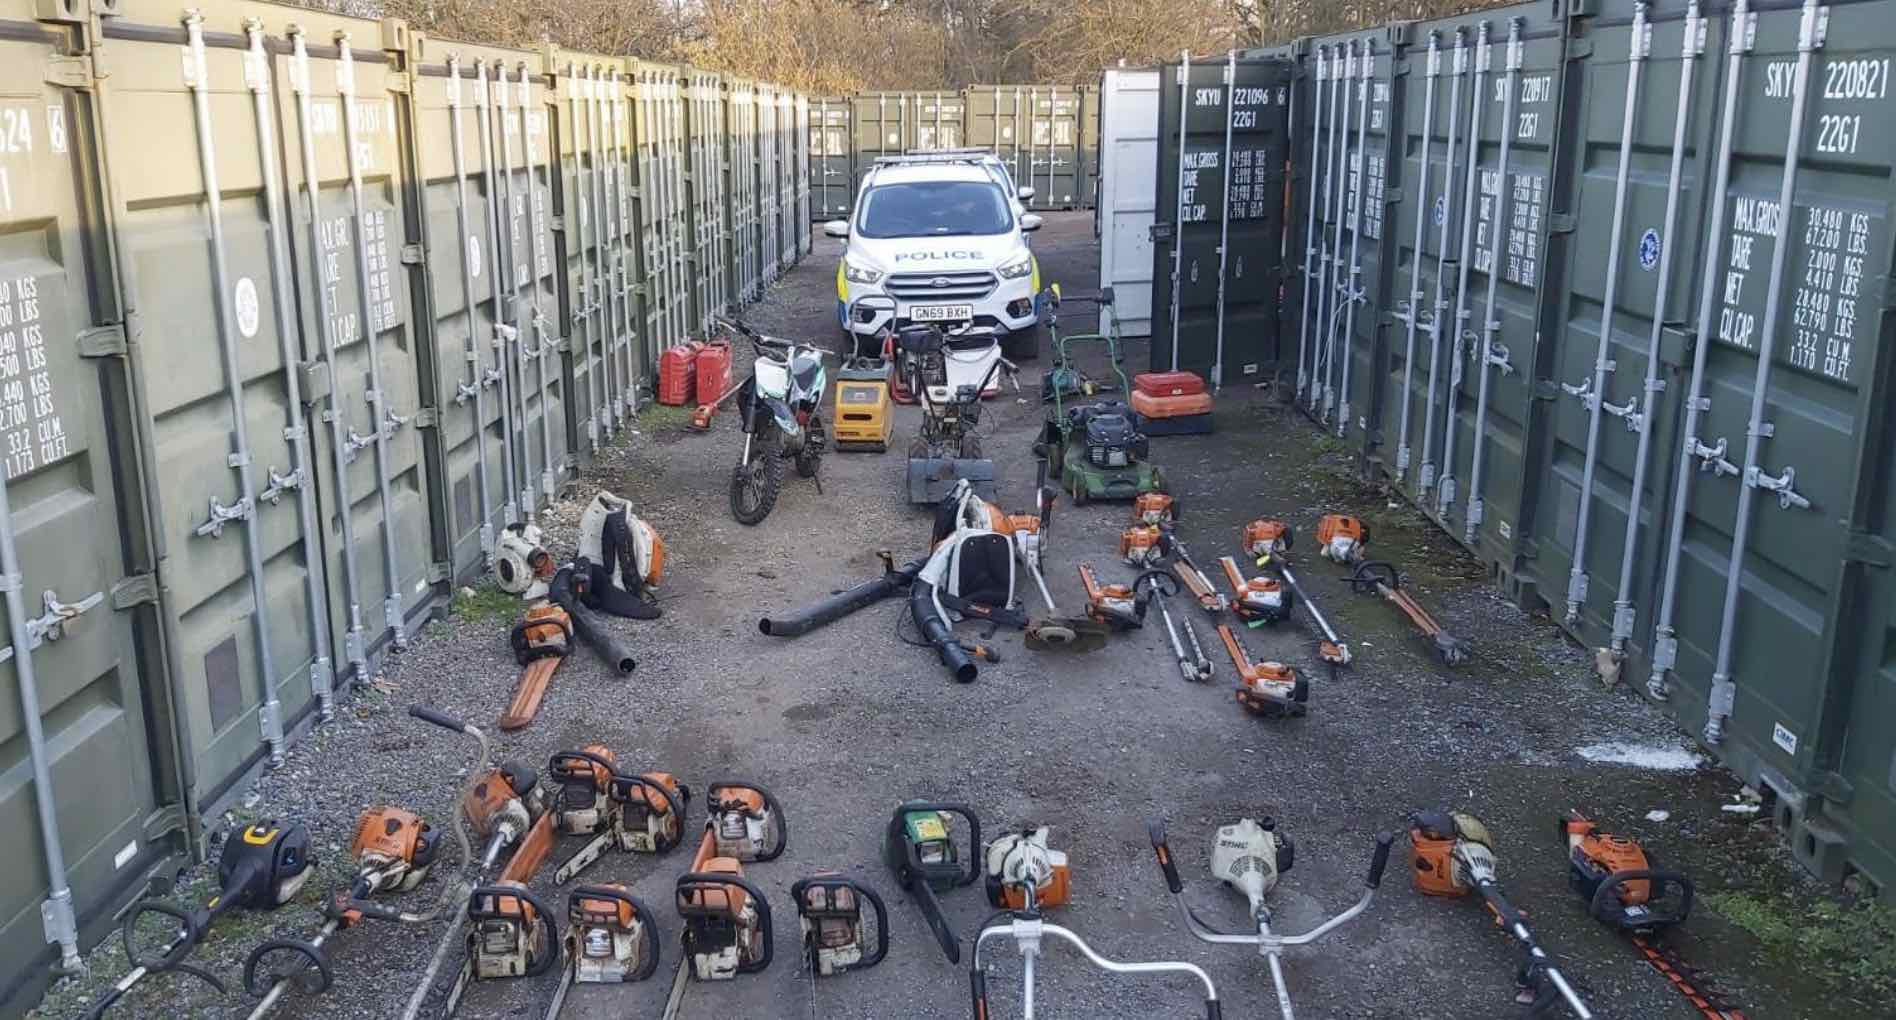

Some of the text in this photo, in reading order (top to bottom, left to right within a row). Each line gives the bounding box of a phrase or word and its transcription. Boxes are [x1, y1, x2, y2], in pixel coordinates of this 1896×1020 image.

[1521, 76, 1551, 102] 220917
[1824, 59, 1889, 99] 220821
[1195, 88, 1221, 106] SKYU
[1234, 88, 1269, 105] 221096
[1233, 111, 1257, 128] 22G1
[1519, 113, 1539, 138] 22G1
[1817, 114, 1860, 154] 22G1
[1734, 197, 1780, 236] MAX.GROS
[1808, 207, 1842, 230] 30.480
[1805, 227, 1840, 249] 67.200
[895, 250, 985, 262] POLICE
[1731, 234, 1753, 270] TARE
[1808, 249, 1836, 271] 2.000
[17, 277, 38, 301] KGS
[1724, 272, 1744, 305] NET
[20, 299, 40, 323] LBS
[915, 305, 969, 319] GN69 BXH
[23, 324, 43, 349] KGS
[26, 346, 46, 371] LBS
[31, 371, 50, 397] KGS
[34, 393, 54, 418] LBS
[8, 429, 31, 455] 33.2
[6, 450, 34, 479] 1.173
